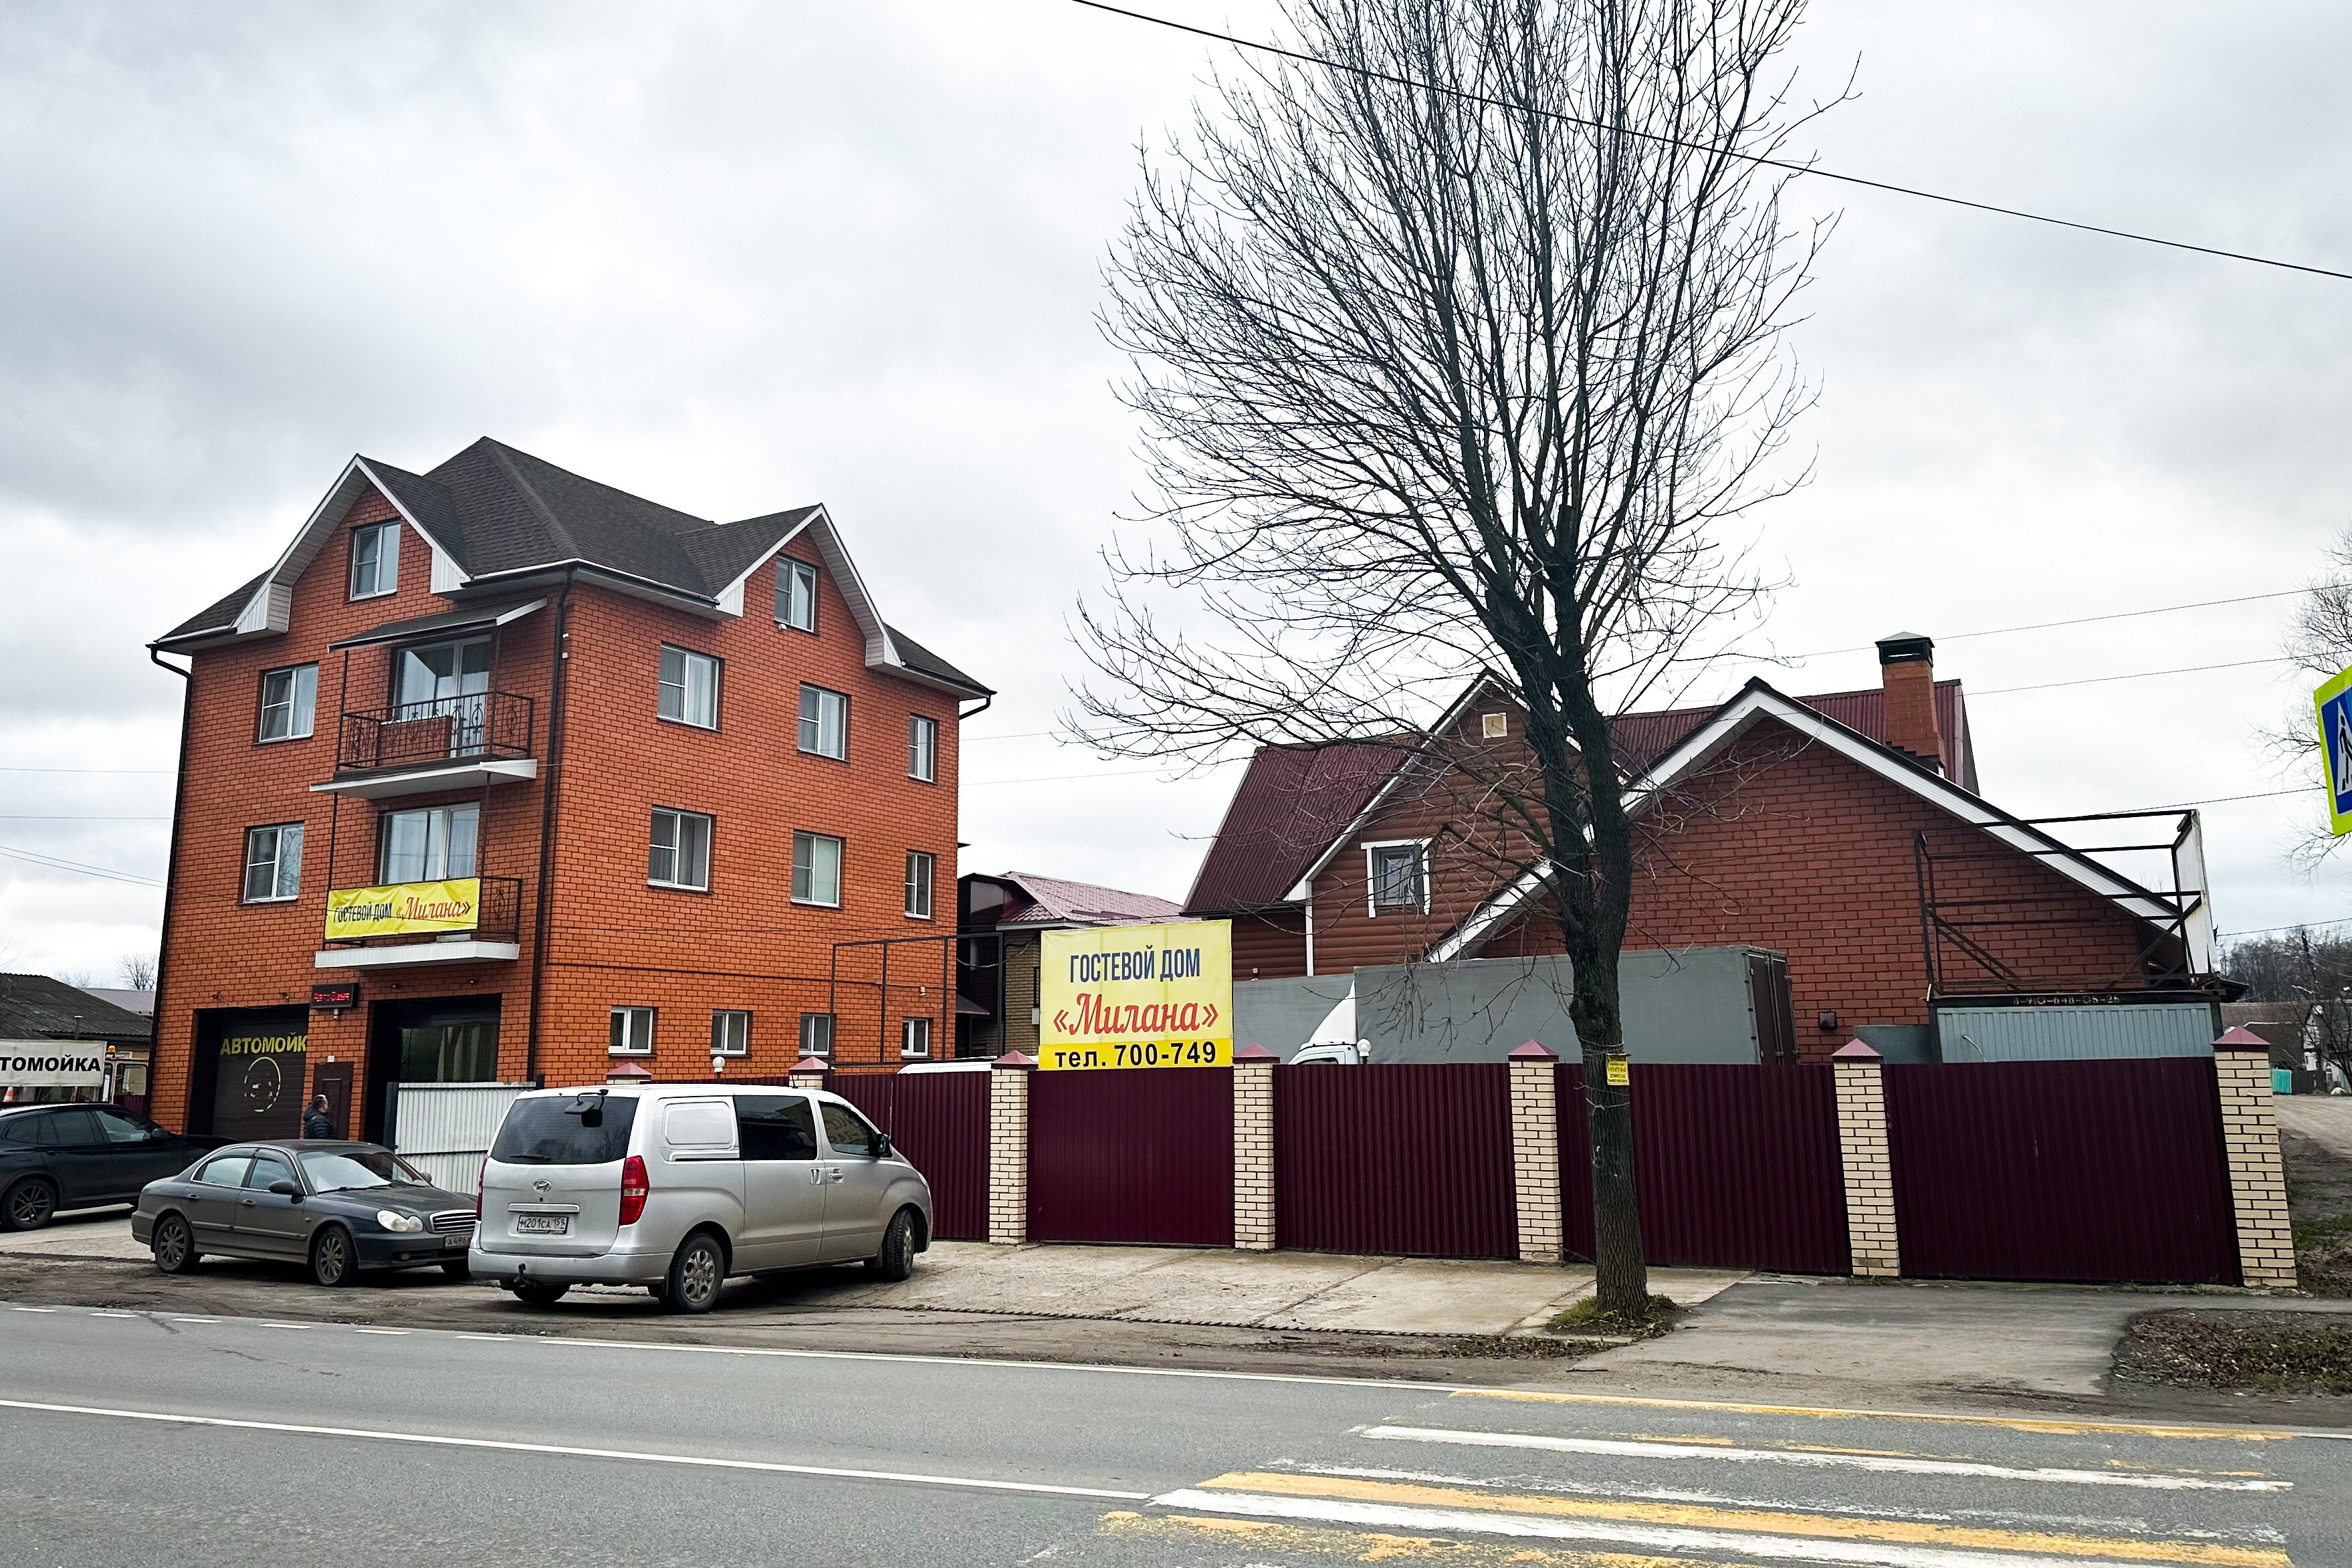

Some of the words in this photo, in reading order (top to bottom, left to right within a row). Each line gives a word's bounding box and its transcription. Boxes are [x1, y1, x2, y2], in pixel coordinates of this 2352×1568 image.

[334, 901, 371, 923] ГОСТЕВОЙ
[372, 903, 393, 922] ДОМ
[396, 897, 472, 921] «Милана»
[1070, 944, 1155, 983] ГОСТЕВОЙ
[1160, 948, 1200, 982] ДОМ
[1053, 992, 1219, 1036] «Милана»
[1055, 1050, 1107, 1068] тел.
[1113, 1041, 1216, 1067] 700-749
